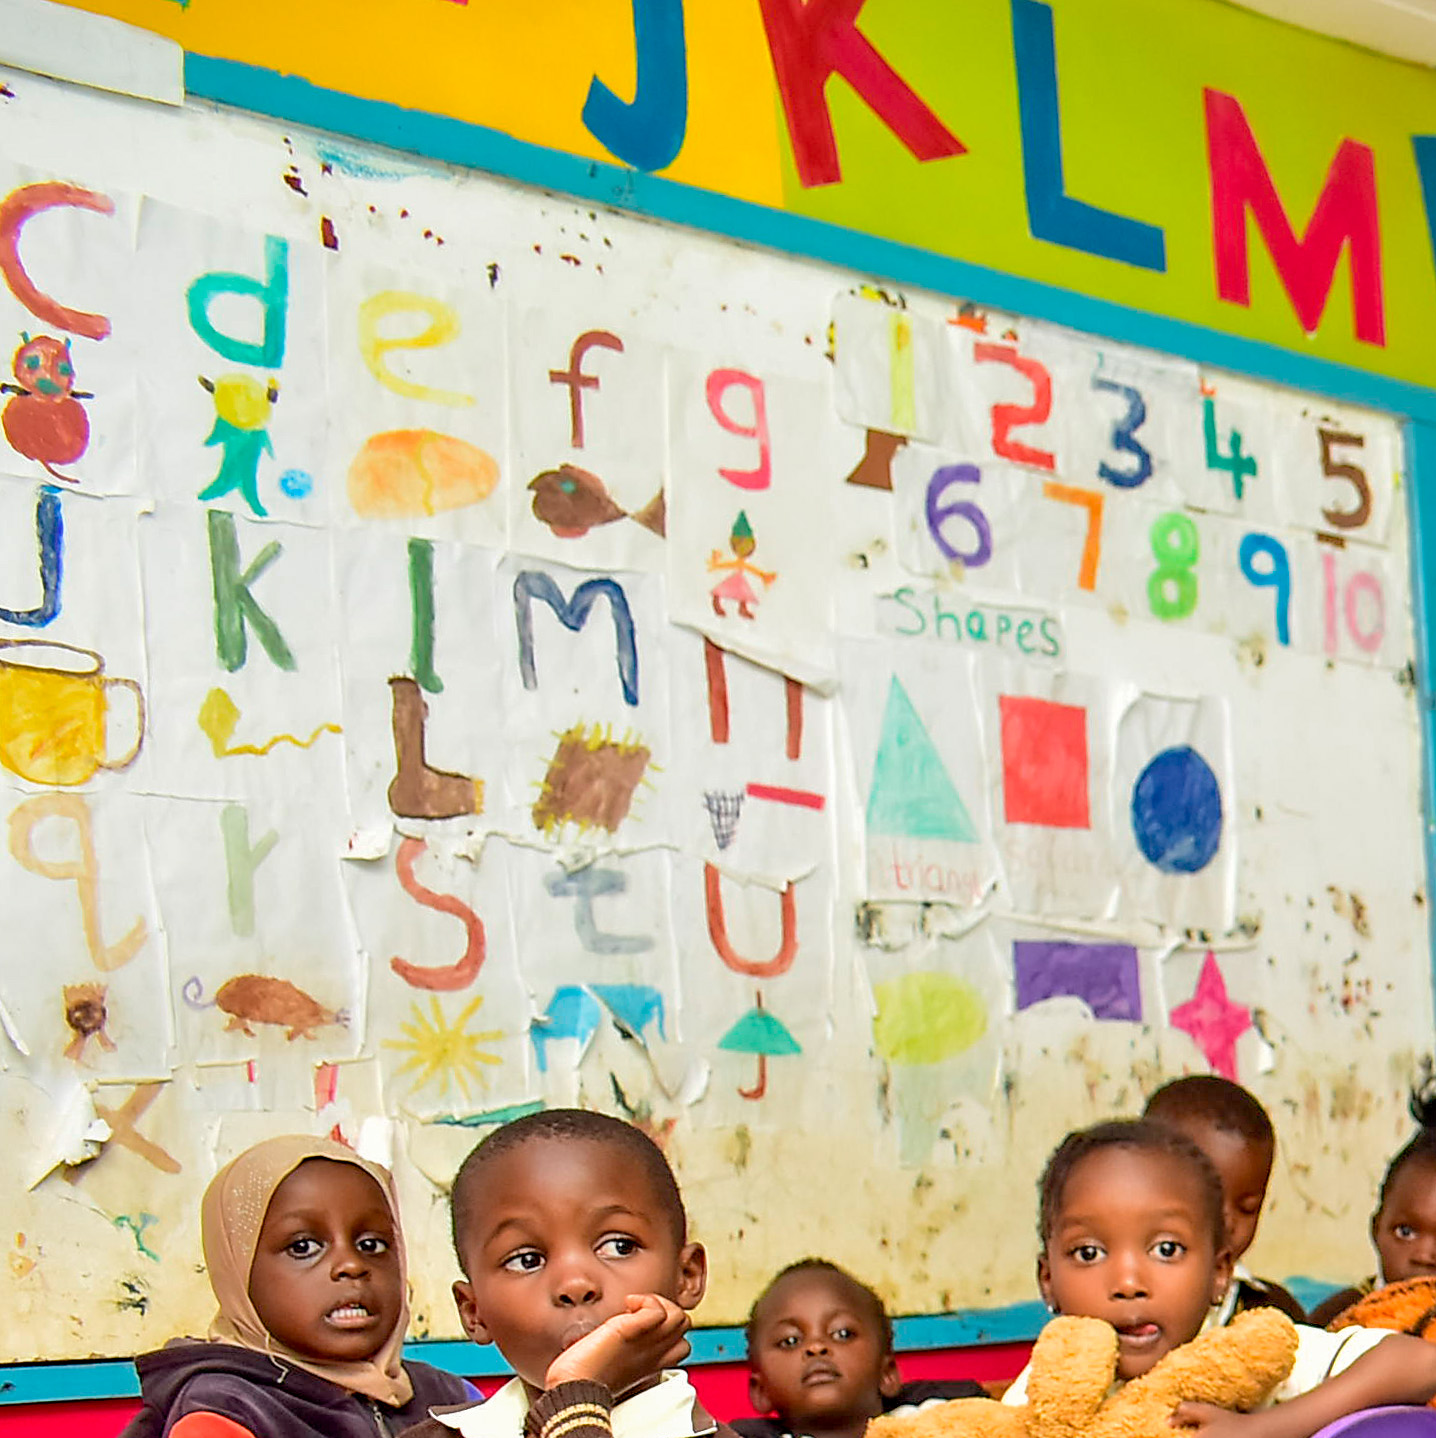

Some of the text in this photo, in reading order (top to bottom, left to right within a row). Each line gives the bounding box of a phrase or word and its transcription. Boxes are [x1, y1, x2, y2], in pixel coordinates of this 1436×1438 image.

[582, 0, 687, 172] J
[759, 0, 968, 188] K
[1011, 0, 1166, 272] L
[1204, 86, 1385, 348] M
[185, 235, 289, 369] d
[358, 291, 477, 407] e
[548, 330, 624, 448] f
[705, 368, 772, 490] g
[973, 342, 1055, 470] 2
[1091, 377, 1153, 489] 3
[1204, 396, 1257, 499] 4
[1317, 428, 1372, 529] 5
[925, 463, 1384, 655] 6 7 8 9 10
